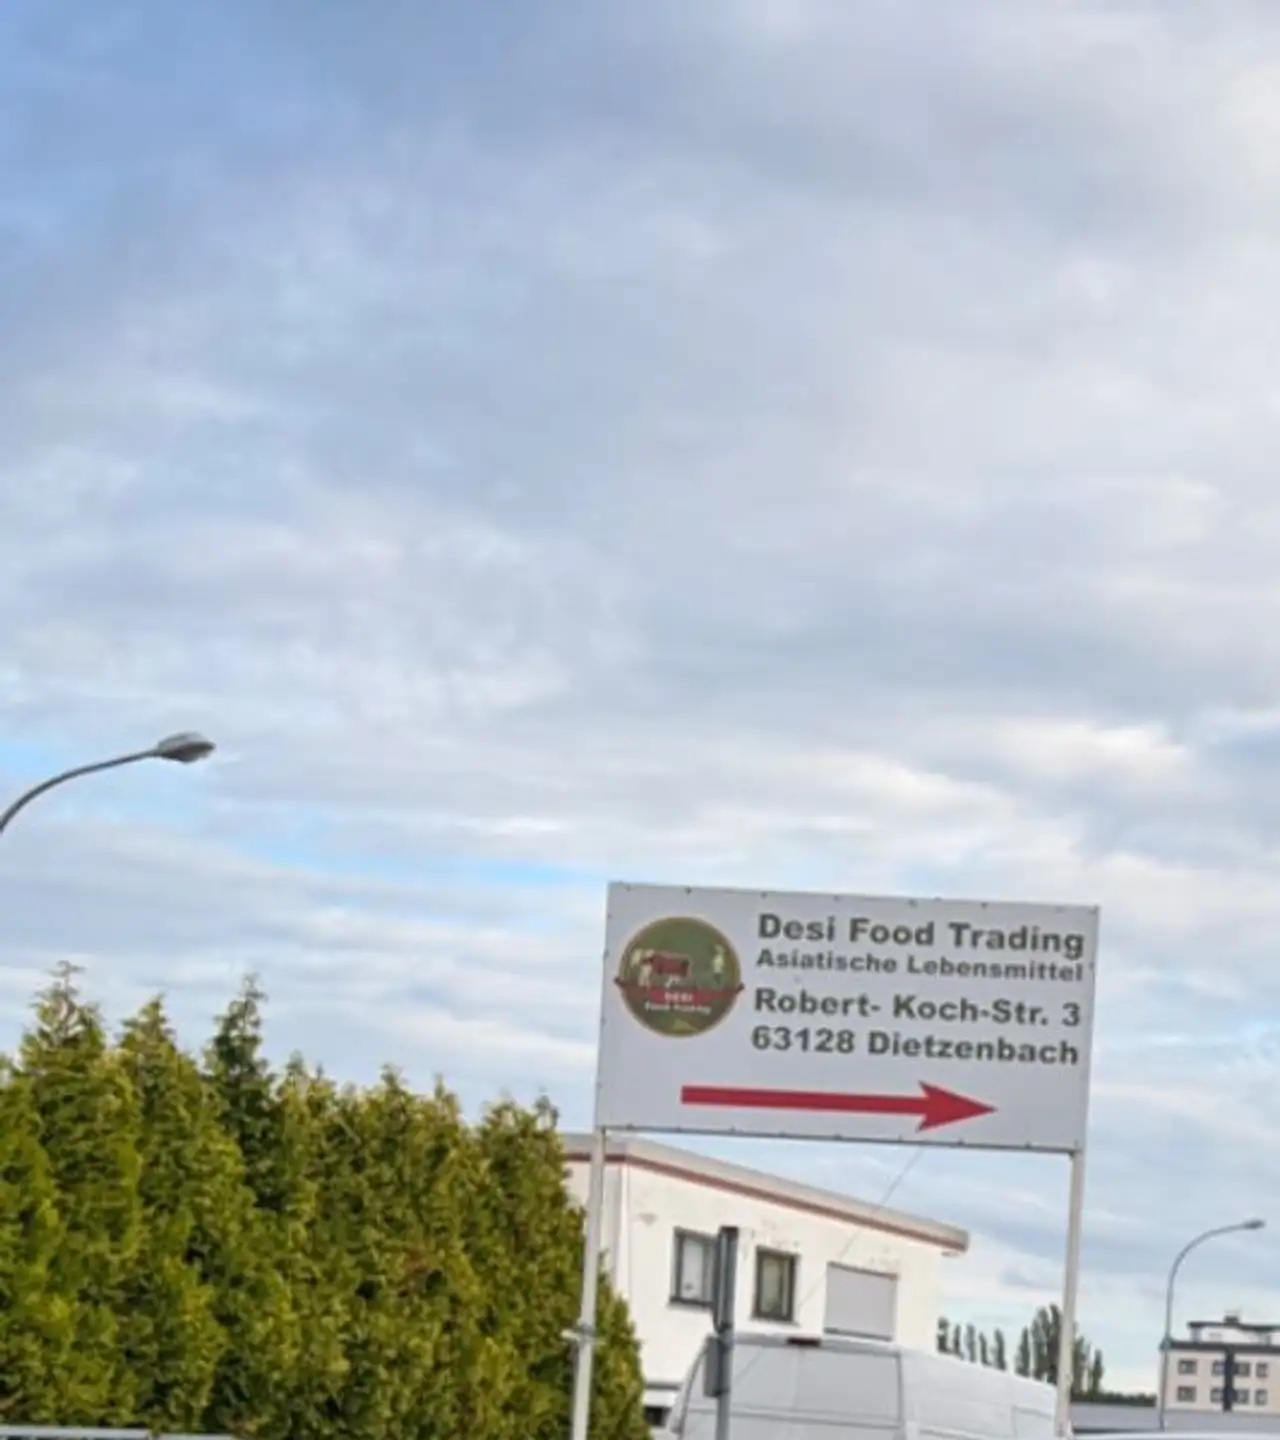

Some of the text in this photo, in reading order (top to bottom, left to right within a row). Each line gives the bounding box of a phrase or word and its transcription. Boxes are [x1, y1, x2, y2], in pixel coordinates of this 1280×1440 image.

[758, 913, 1084, 960] Desi Food Trading
[756, 948, 1083, 982] Asiatische Lebensmittel
[755, 987, 1081, 1028] Robert- Koch-Str. 3
[752, 1025, 1079, 1066] 63128 Dietzenbach
